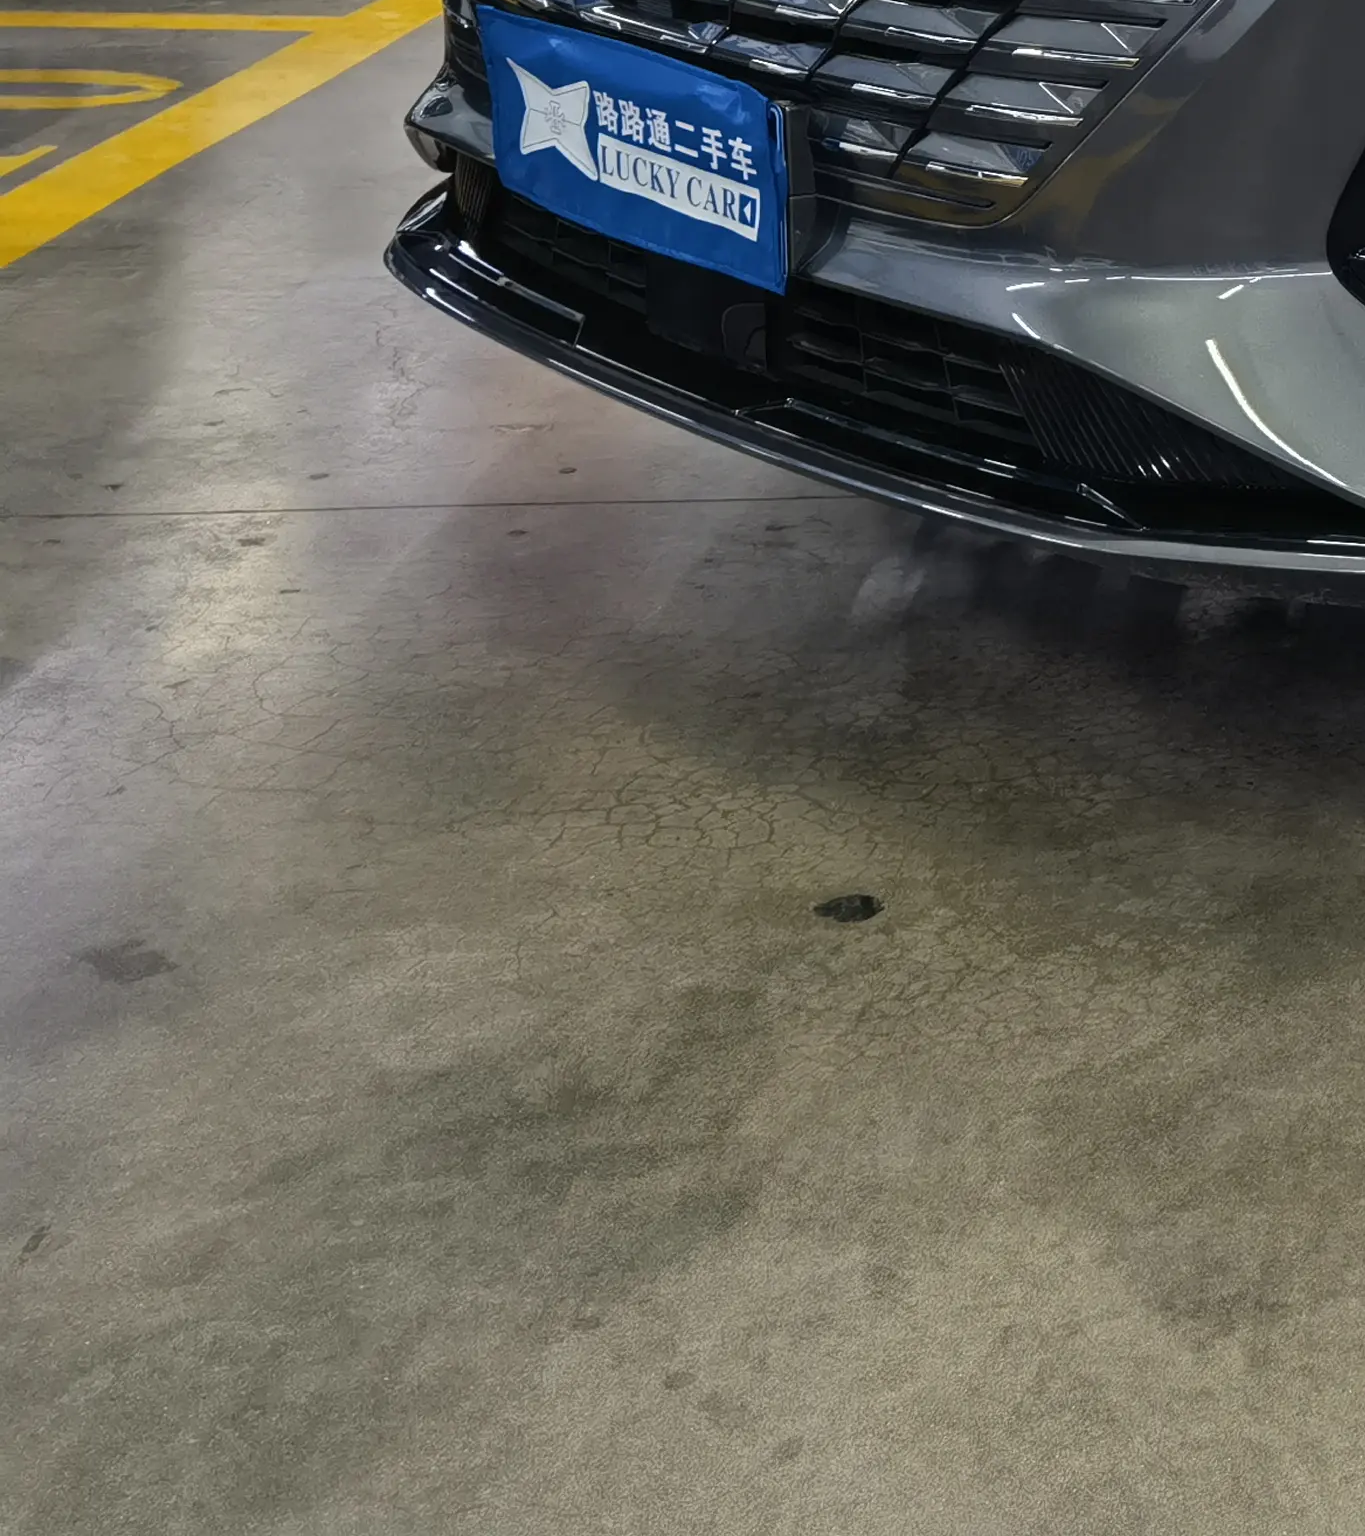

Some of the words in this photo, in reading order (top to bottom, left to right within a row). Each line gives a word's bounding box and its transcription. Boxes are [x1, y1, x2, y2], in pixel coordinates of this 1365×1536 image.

[592, 90, 758, 182] 路路通二手车
[600, 144, 681, 200] LUCKY
[686, 177, 738, 221] CAR
